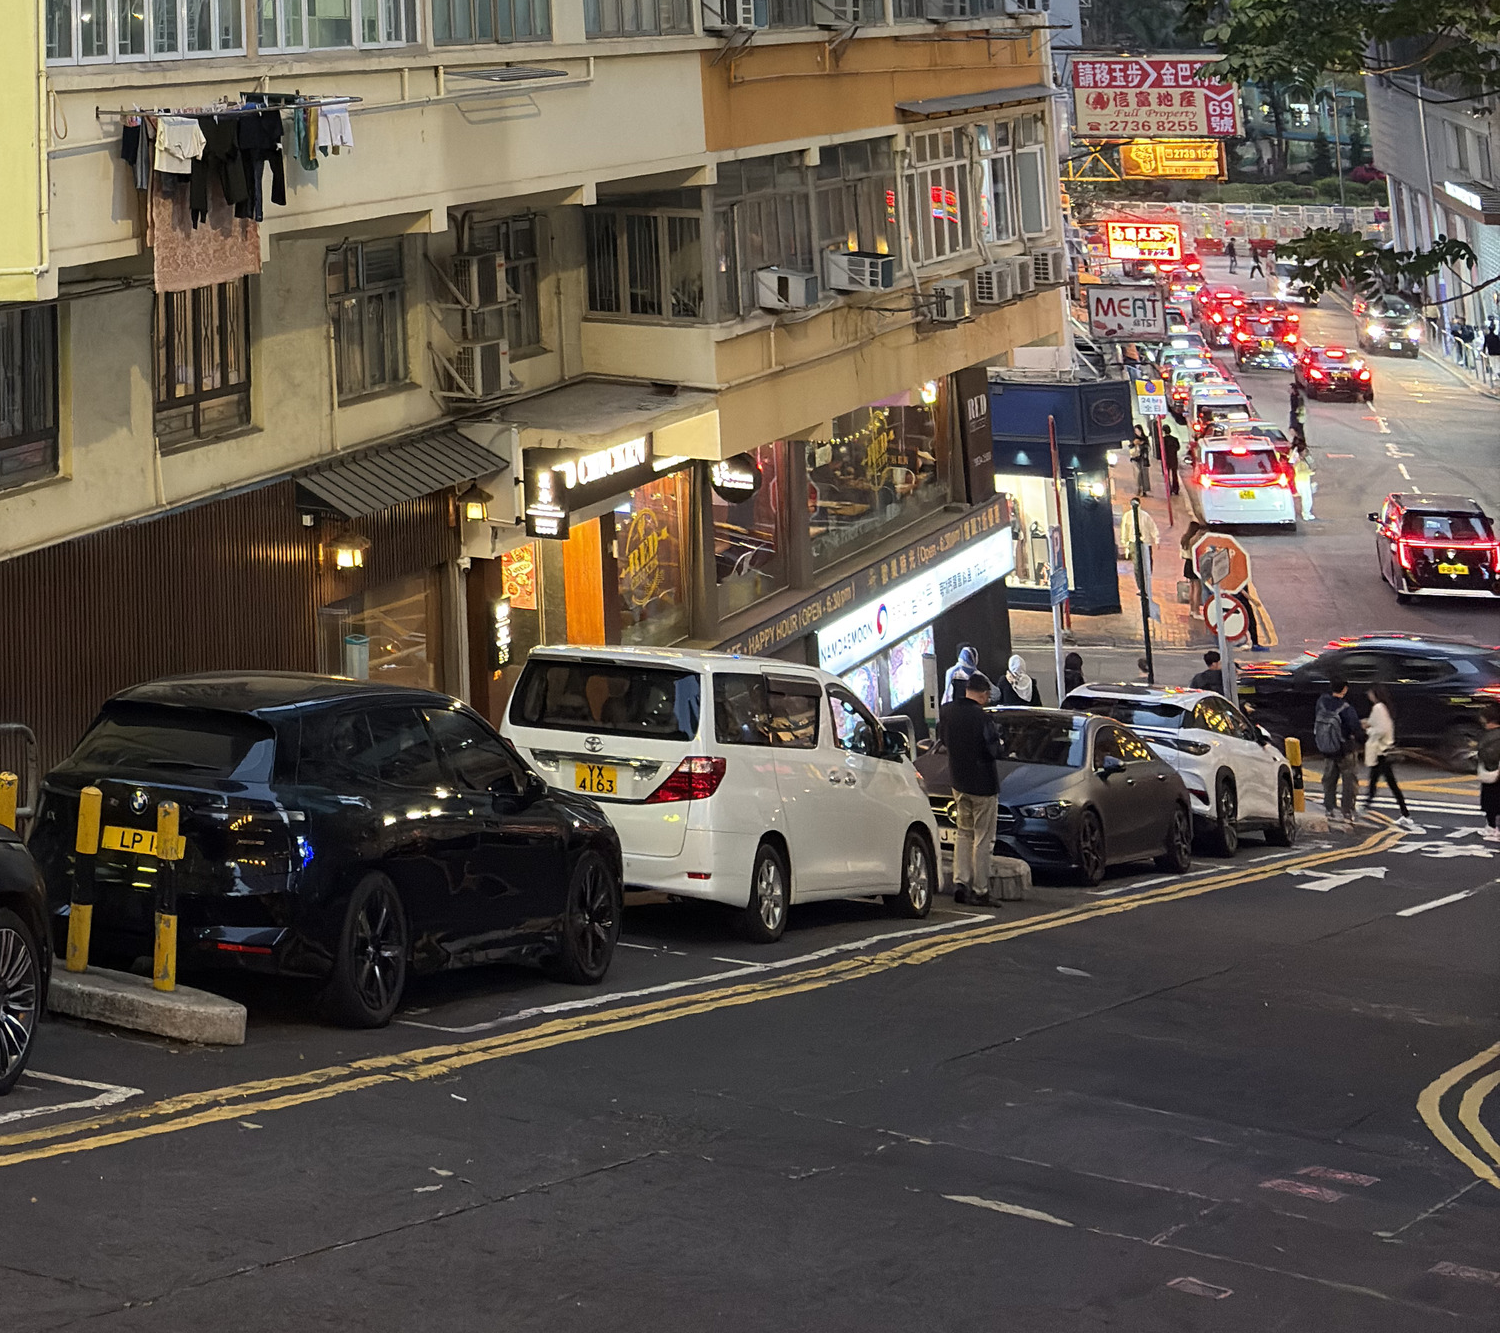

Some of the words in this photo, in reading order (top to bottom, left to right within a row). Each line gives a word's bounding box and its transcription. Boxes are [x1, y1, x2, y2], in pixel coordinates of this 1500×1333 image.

[1077, 62, 1143, 88] 請移玉步
[1112, 90, 1198, 109] 信富地產
[1208, 100, 1234, 116] 69
[1113, 108, 1141, 118] Full
[1145, 108, 1198, 121] Property
[1156, 120, 1199, 133] 8255
[1210, 116, 1235, 133] 號
[1095, 296, 1160, 319] MEAT
[748, 625, 776, 656] HAPPY
[776, 613, 799, 641] HOUR
[820, 621, 874, 663] NAMDAEMOON
[587, 764, 604, 779] YX
[579, 777, 614, 793] 4163
[119, 830, 143, 849] LP
